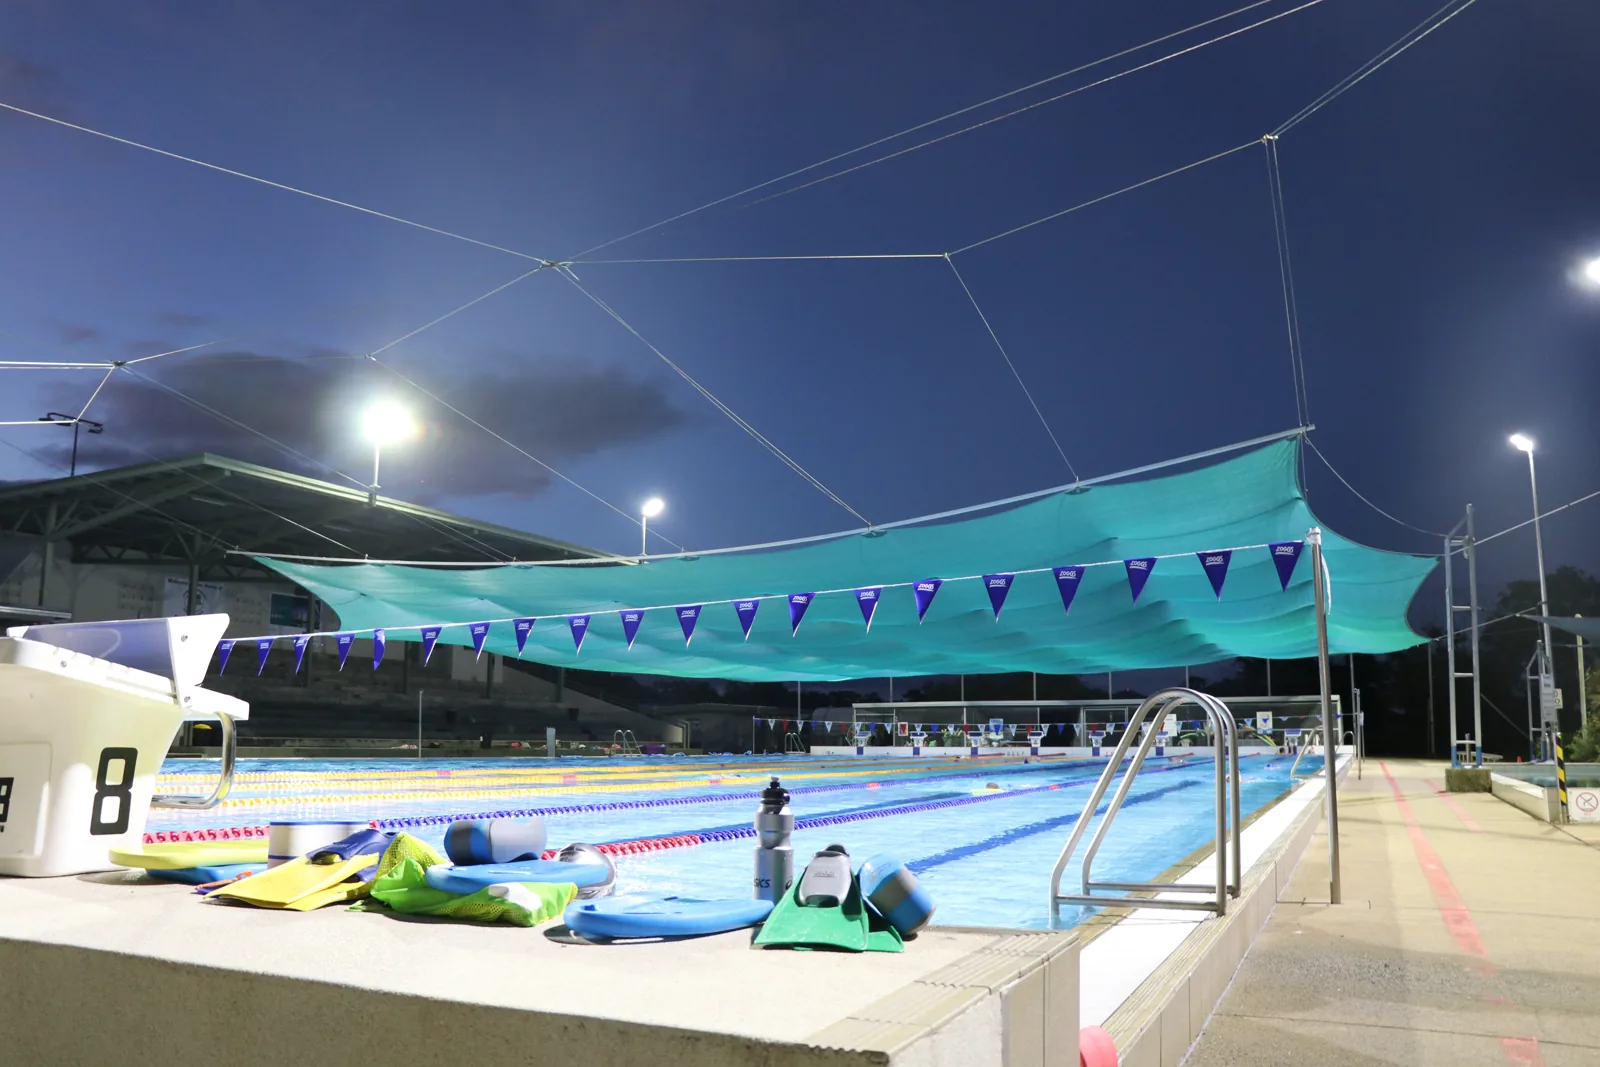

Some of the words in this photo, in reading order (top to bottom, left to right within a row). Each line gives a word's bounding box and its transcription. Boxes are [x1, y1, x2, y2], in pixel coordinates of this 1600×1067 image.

[1206, 555, 1223, 563] ZOGGS
[1130, 560, 1148, 568] ZOGGS
[90, 747, 138, 836] 8
